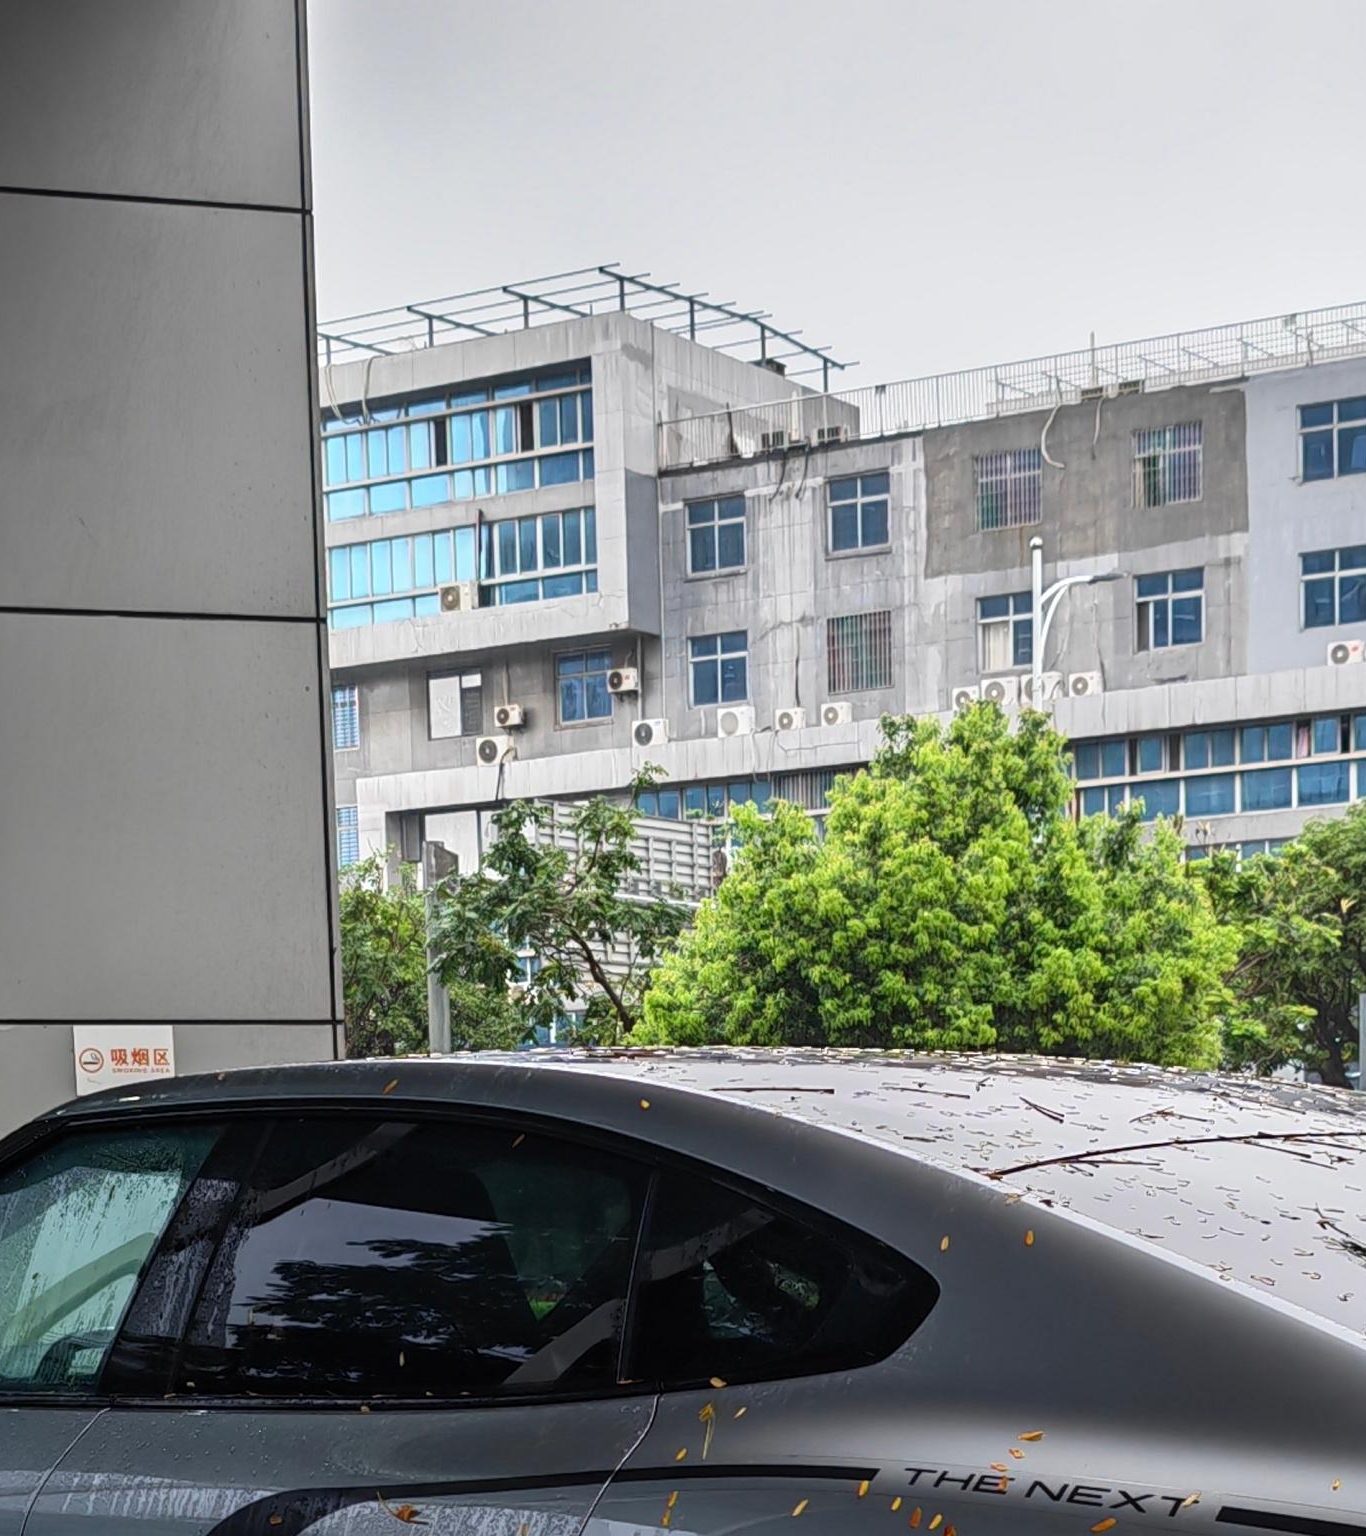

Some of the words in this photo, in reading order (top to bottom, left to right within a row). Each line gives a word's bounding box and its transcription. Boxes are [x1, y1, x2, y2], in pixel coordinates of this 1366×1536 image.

[110, 1047, 170, 1066] 吸烟区
[904, 1467, 1016, 1496] THE
[1025, 1480, 1201, 1518] NEXT
